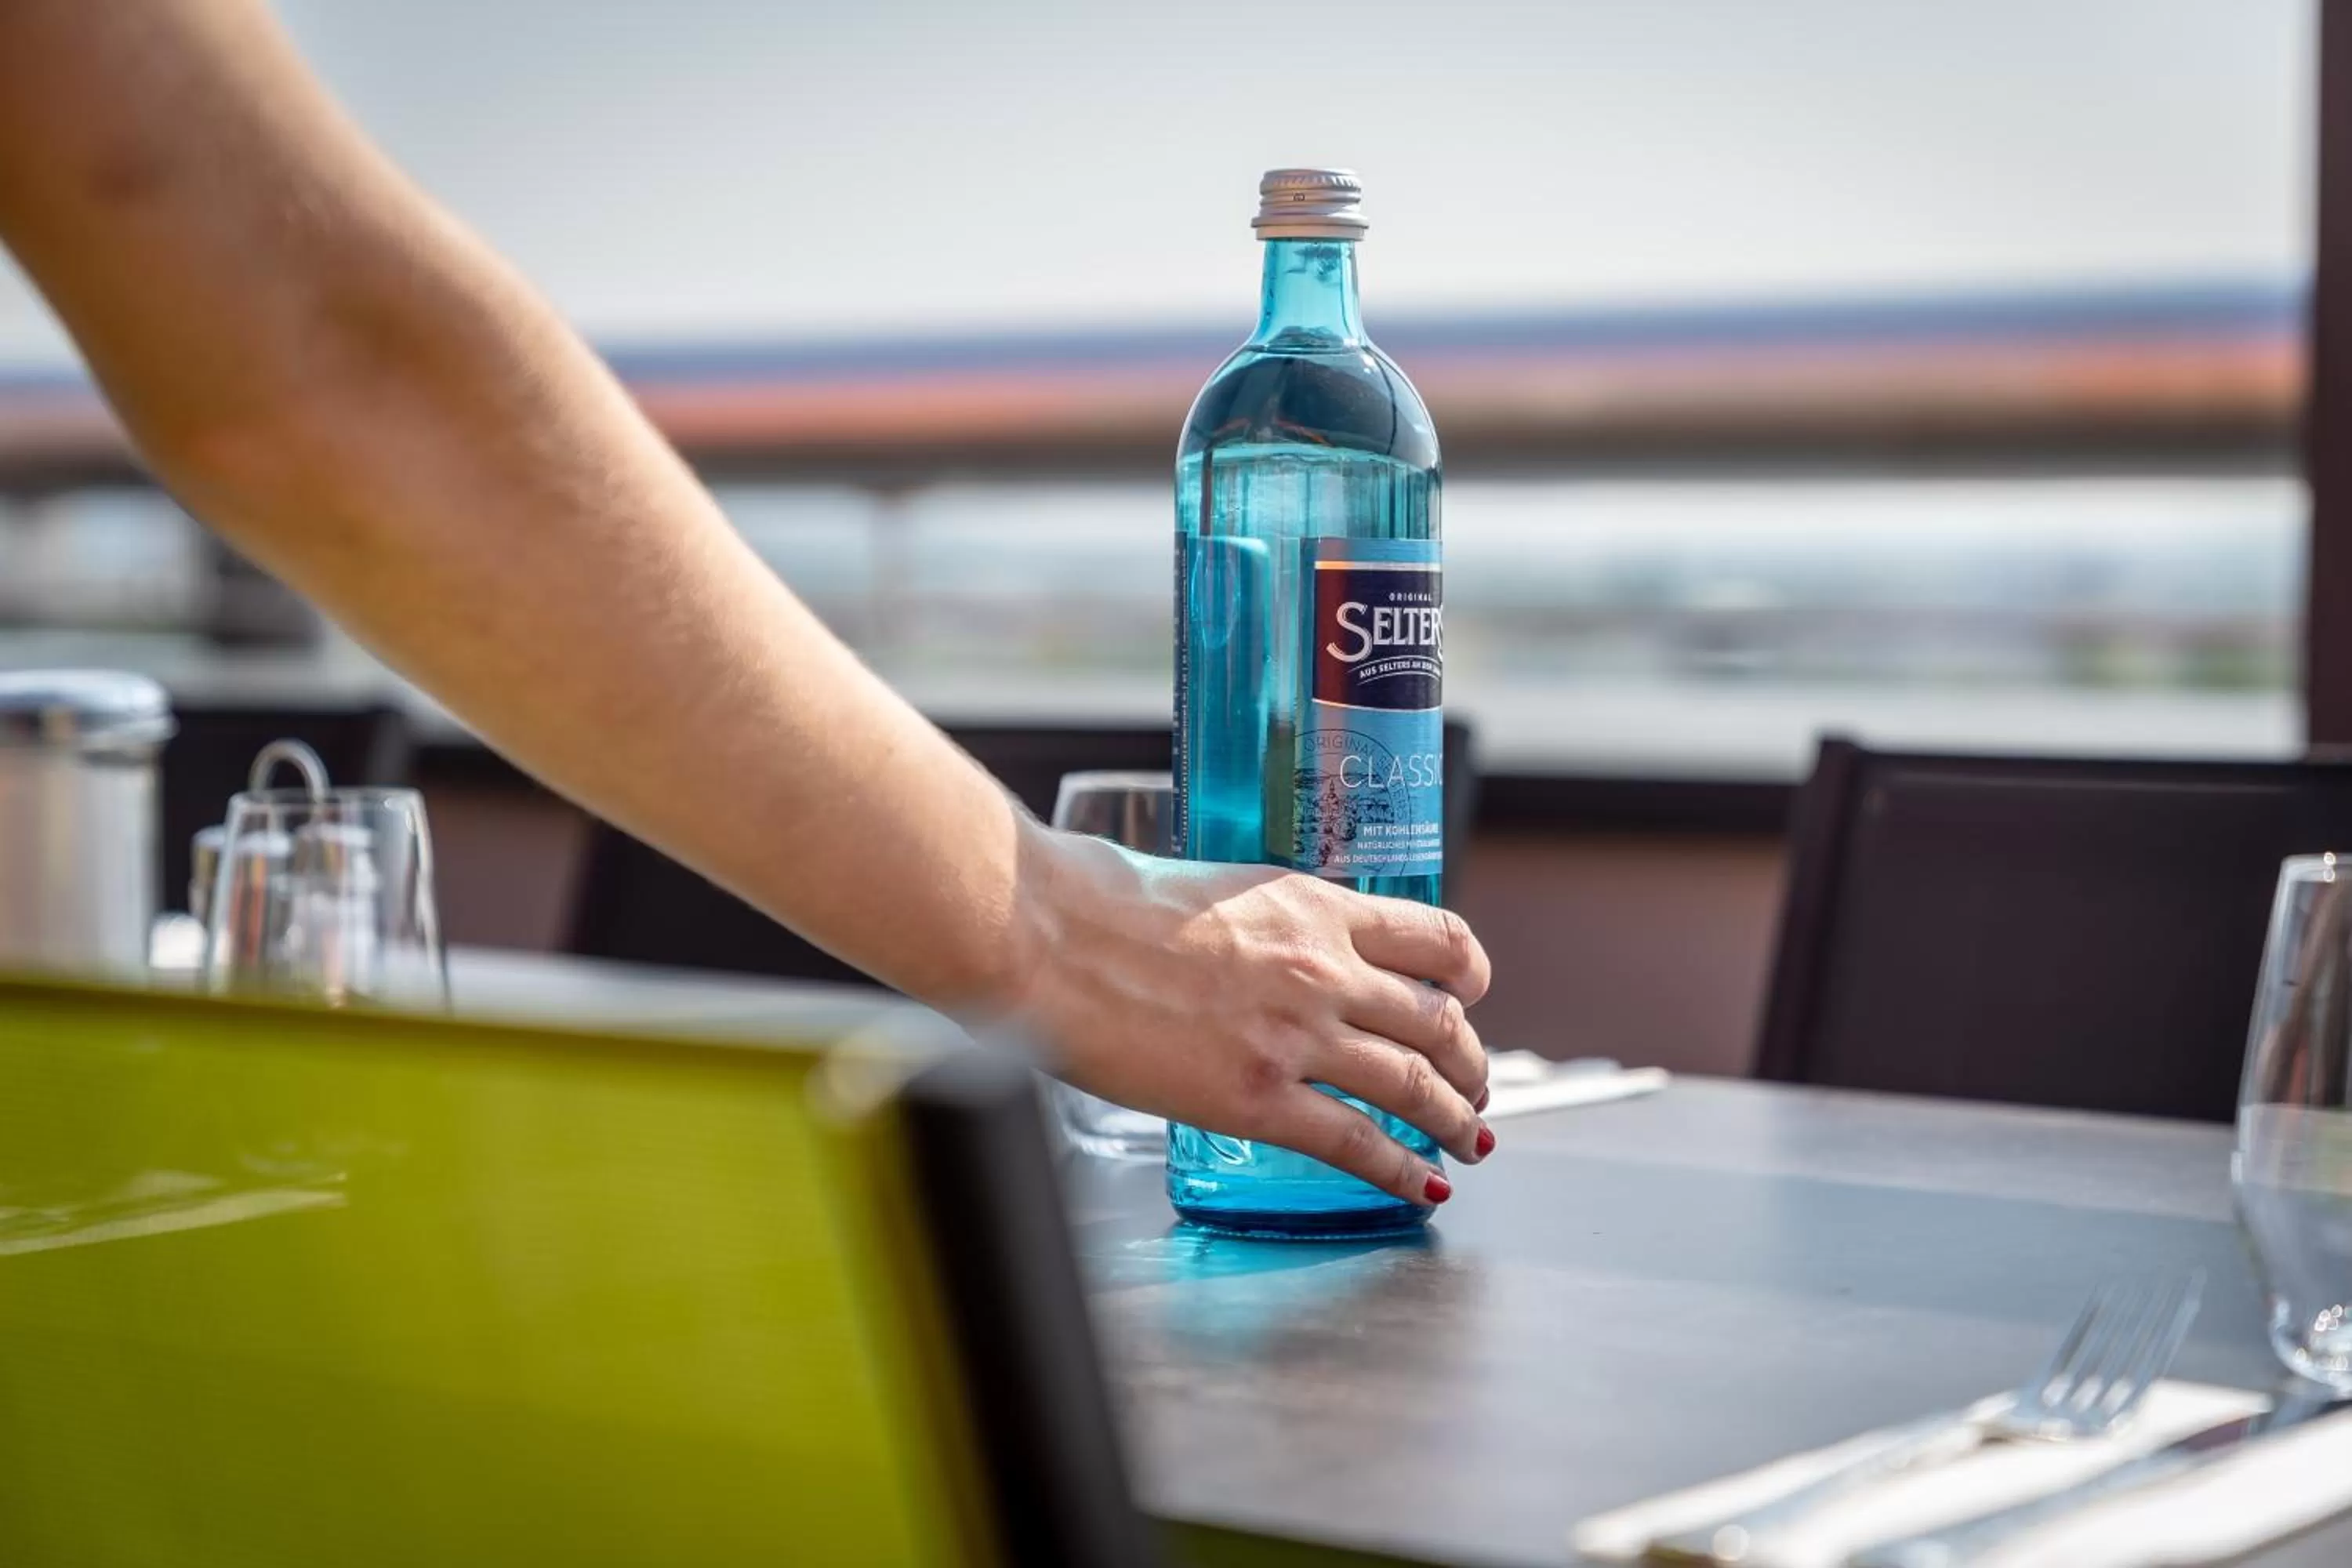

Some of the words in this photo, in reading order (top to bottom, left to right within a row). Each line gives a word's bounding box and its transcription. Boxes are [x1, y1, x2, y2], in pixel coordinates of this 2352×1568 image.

[1388, 592, 1433, 602] ORIGINAL
[1359, 666, 1377, 679] AUS
[1378, 661, 1410, 673] SELTERS
[1363, 826, 1383, 837] MIT
[1334, 855, 1351, 863] AUS
